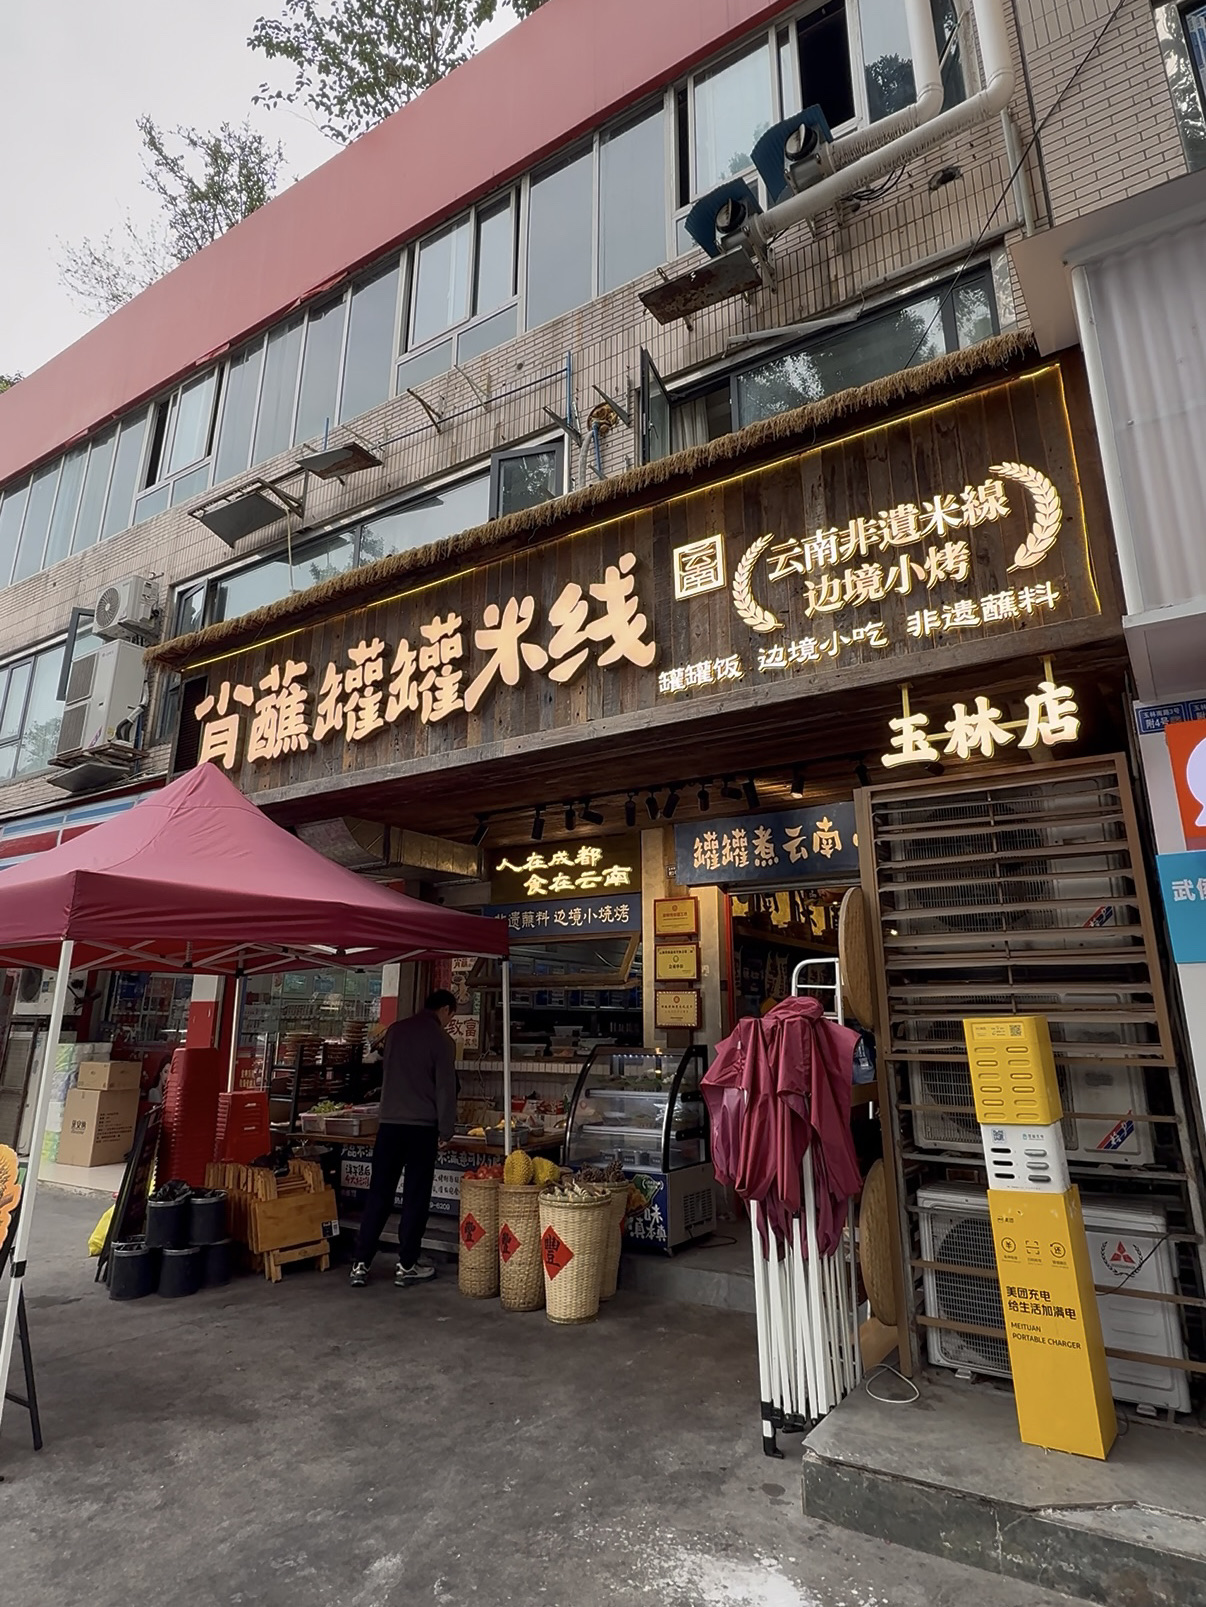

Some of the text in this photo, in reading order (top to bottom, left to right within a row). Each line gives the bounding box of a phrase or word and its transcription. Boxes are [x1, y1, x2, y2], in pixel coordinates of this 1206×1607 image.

[767, 478, 1011, 582] 云南非遺米線
[803, 540, 971, 618] 边境小烤
[657, 580, 1061, 694] 罐罐饭 边境小吃 非遗蘸料
[881, 681, 1081, 769] 玉林店
[693, 816, 858, 870] 罐罐煮云南
[495, 845, 603, 872] 人在成都
[523, 864, 633, 896] 食在云南
[553, 904, 630, 927] 边境小烧烤
[1006, 1286, 1051, 1302] 美团充电
[1008, 1300, 1077, 1320] 给生活加满电
[1011, 1322, 1041, 1333] MEITUAN
[1012, 1333, 1081, 1350] PORTABLE CHARGER
